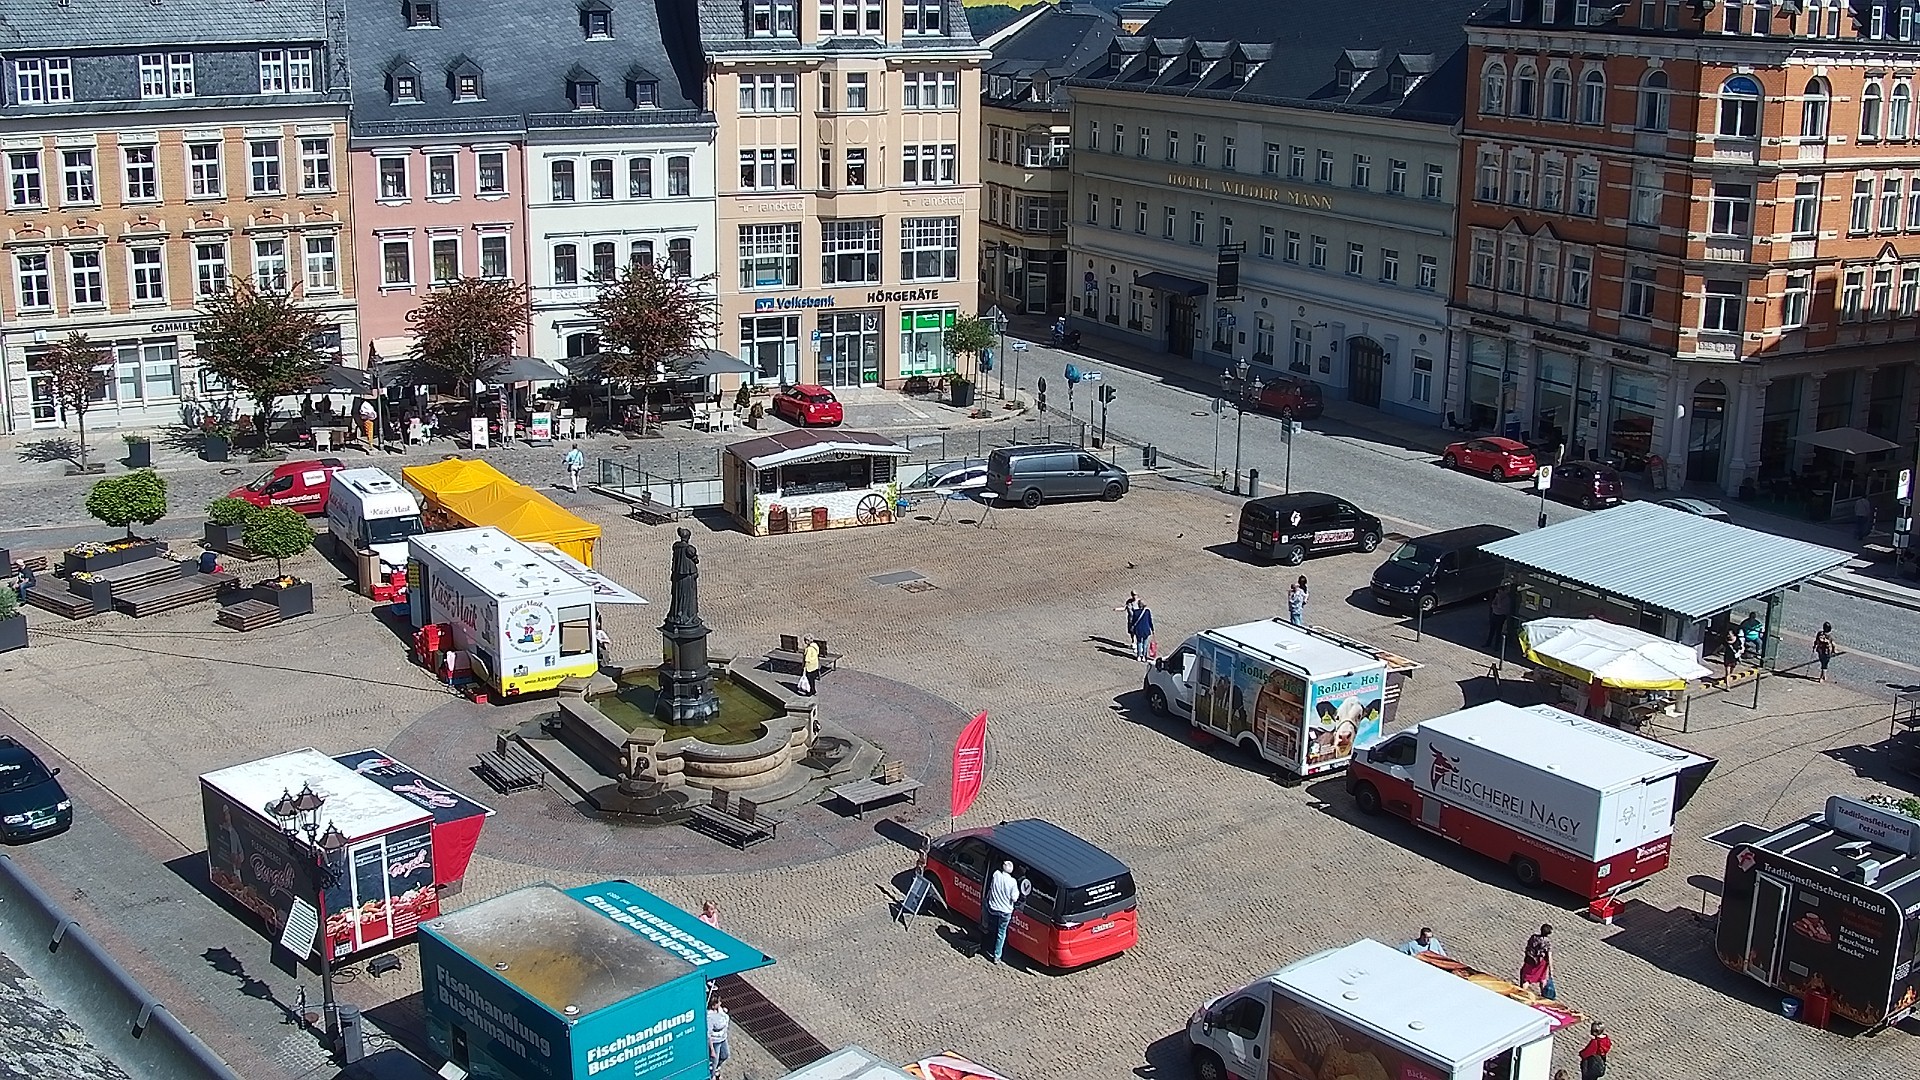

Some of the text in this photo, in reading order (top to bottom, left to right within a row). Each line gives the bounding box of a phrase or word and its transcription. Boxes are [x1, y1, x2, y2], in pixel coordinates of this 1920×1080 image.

[1168, 173, 1333, 210] HOTEL WILDER MANN
[777, 295, 835, 310] Volksbank
[867, 289, 939, 303] HÖRGERÄTE
[1317, 681, 1352, 696] Roßler
[1361, 673, 1380, 686] Hof
[1529, 799, 1581, 836] NAGY
[1837, 806, 1911, 837] Traditionsfleischerei
[1858, 822, 1886, 838] Petzold
[1763, 862, 1850, 903] Traditionsfleischerei
[1852, 896, 1886, 916] Petzold
[583, 895, 712, 966] Fischhandlung
[625, 904, 730, 962] Buschmann
[436, 964, 552, 1058] Fischhandlung
[438, 984, 528, 1059] Buschmann
[587, 1009, 696, 1063] Fischhandlung
[588, 1031, 674, 1076] Buschmann
